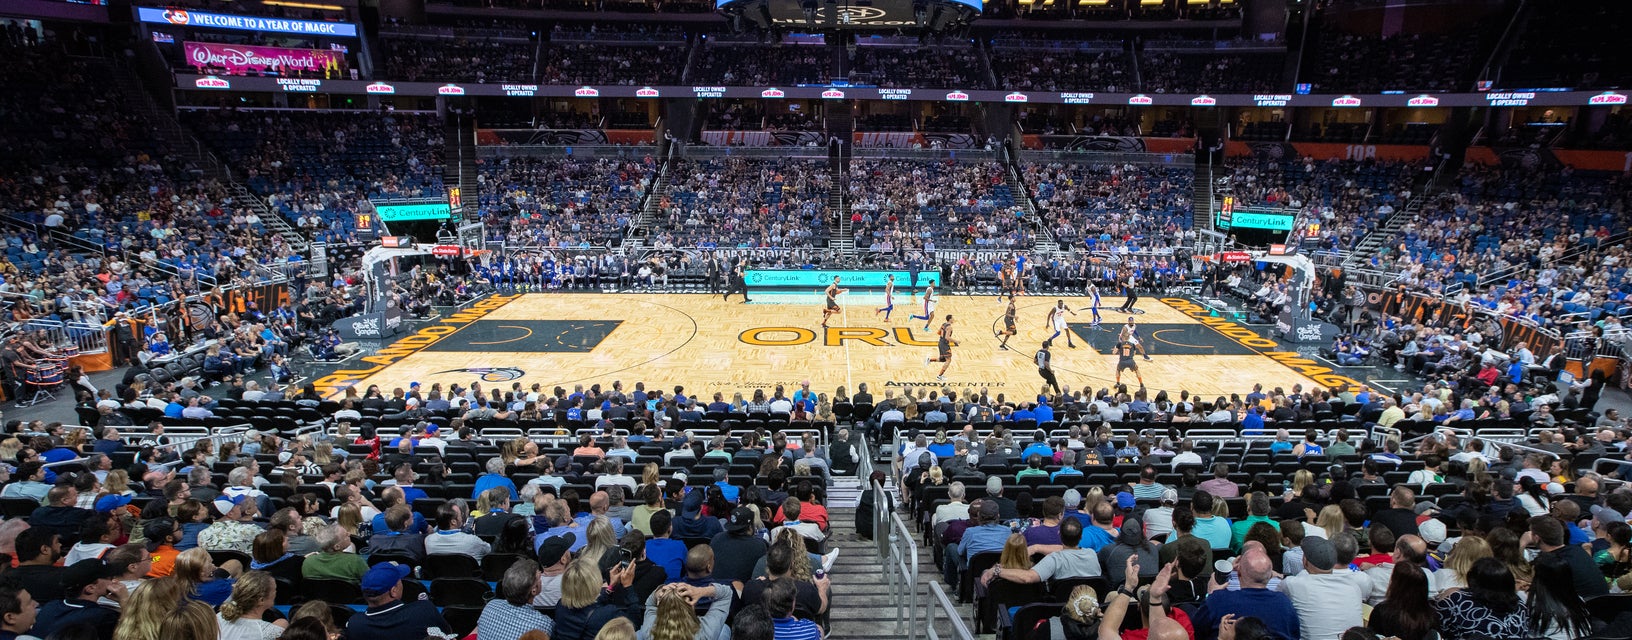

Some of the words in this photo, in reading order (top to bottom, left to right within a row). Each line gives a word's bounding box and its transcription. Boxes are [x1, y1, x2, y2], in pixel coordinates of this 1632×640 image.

[193, 14, 242, 27] WELCOME
[246, 18, 256, 28] TO
[258, 20, 265, 29] A
[265, 20, 290, 30] YEAR
[291, 22, 303, 31] OF
[305, 23, 335, 33] MAGIC
[279, 55, 314, 68] World
[1346, 144, 1376, 161] 108
[400, 208, 450, 216] CenturyLink
[1237, 216, 1285, 226] CenturyLink
[440, 294, 521, 322] MAGIC
[1159, 298, 1278, 347] ORLANDO
[738, 327, 957, 346] ORL
